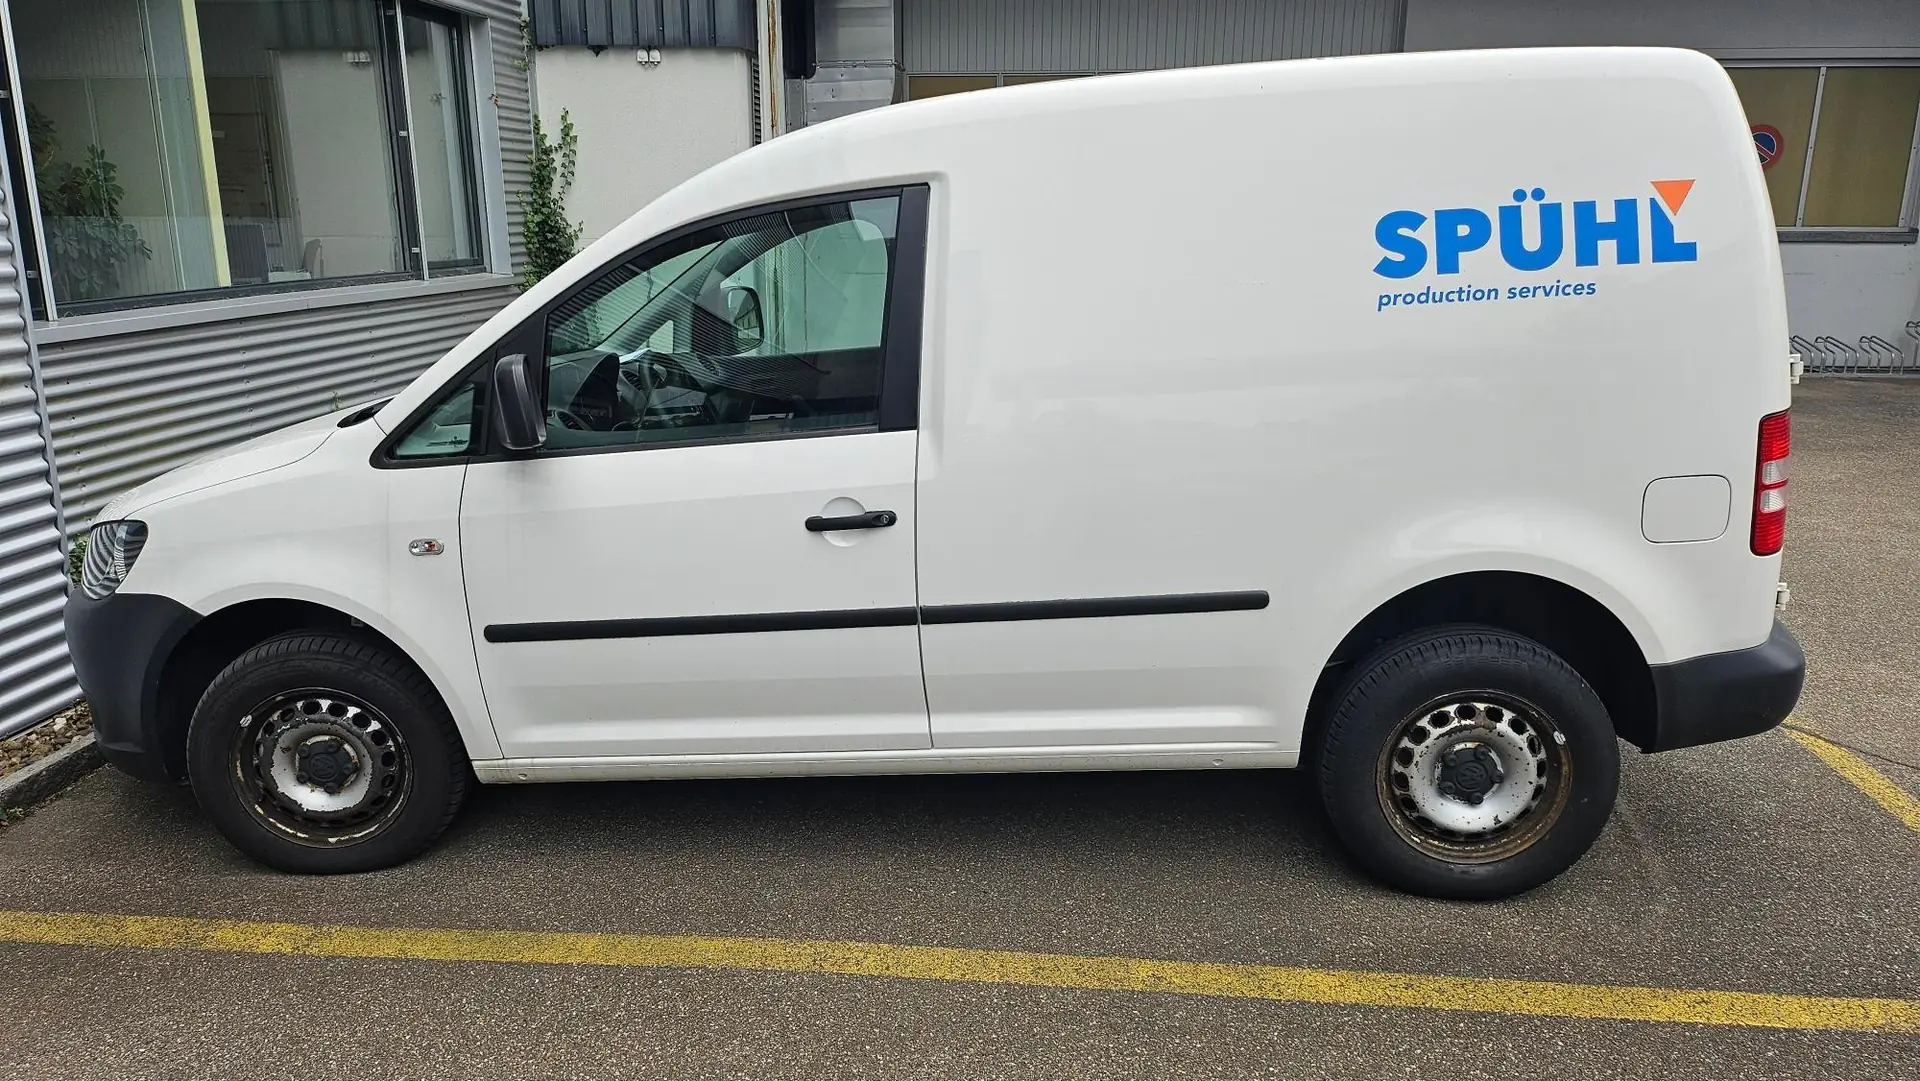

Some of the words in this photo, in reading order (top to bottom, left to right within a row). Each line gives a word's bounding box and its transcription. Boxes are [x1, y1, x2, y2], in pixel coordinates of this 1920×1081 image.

[1373, 186, 1698, 280] SPÜHL
[1377, 284, 1499, 312] production
[1506, 279, 1597, 301] services
